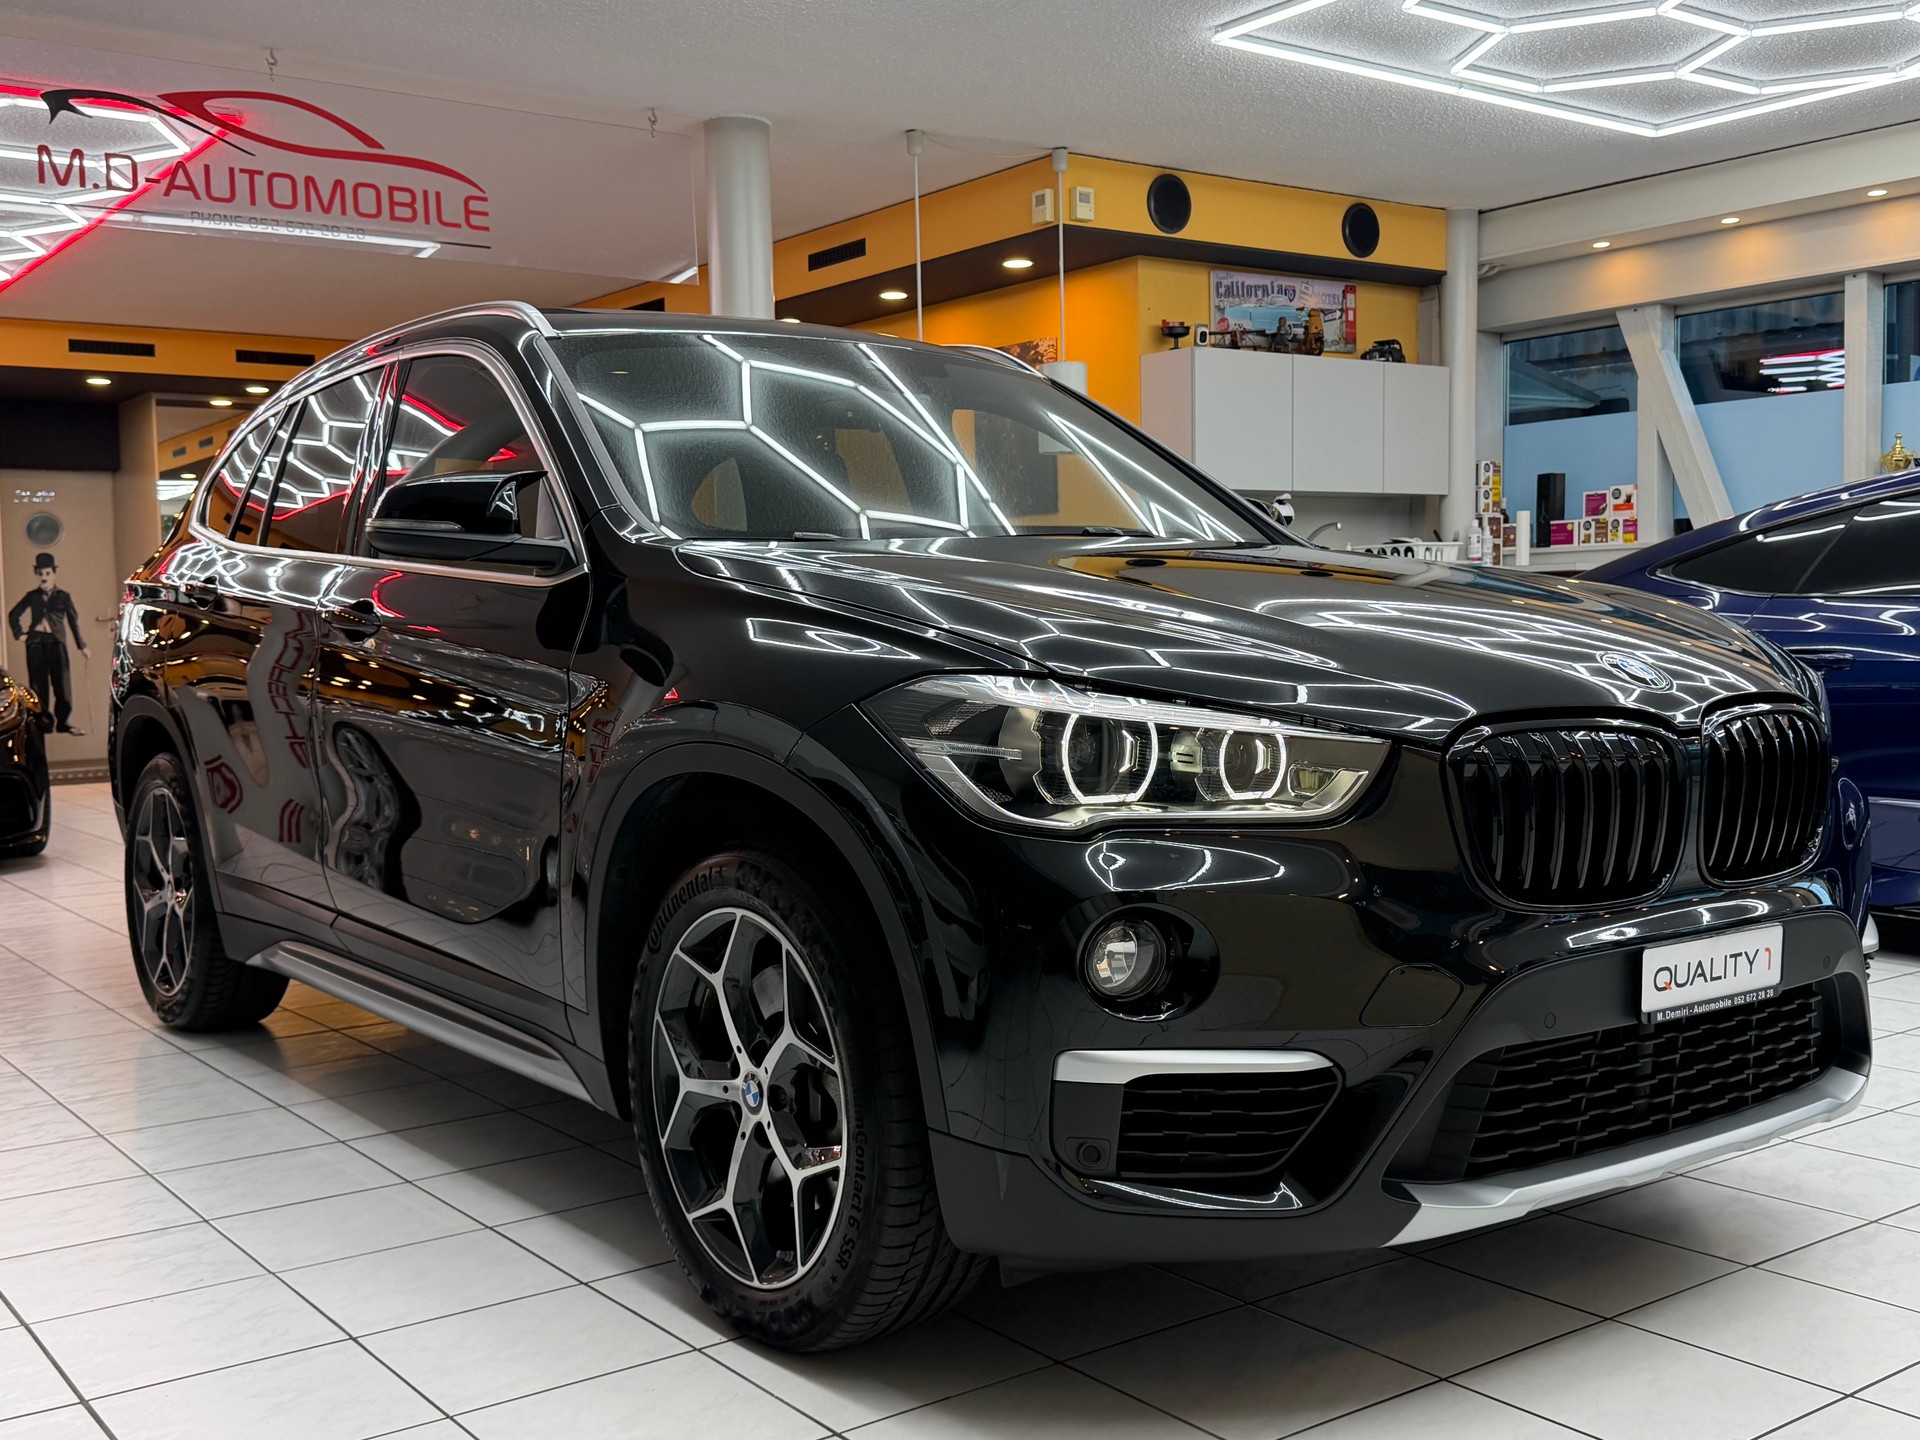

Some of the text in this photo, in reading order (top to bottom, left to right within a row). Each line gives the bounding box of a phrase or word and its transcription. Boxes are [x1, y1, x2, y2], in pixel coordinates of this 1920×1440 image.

[37, 143, 491, 233] M.D-AUTOMOBILE
[190, 210, 243, 228] PHONE
[248, 216, 280, 231] 052
[286, 220, 315, 235] 672
[1215, 280, 1284, 299] California
[647, 866, 716, 955] Continental
[1653, 948, 1760, 993] QUALITY
[1733, 995, 1745, 1005] 052
[1746, 992, 1757, 1002] 672
[1758, 990, 1766, 1000] 28
[1766, 988, 1774, 998] 28
[847, 1214, 861, 1231] 6
[835, 1233, 857, 1270] SSR
